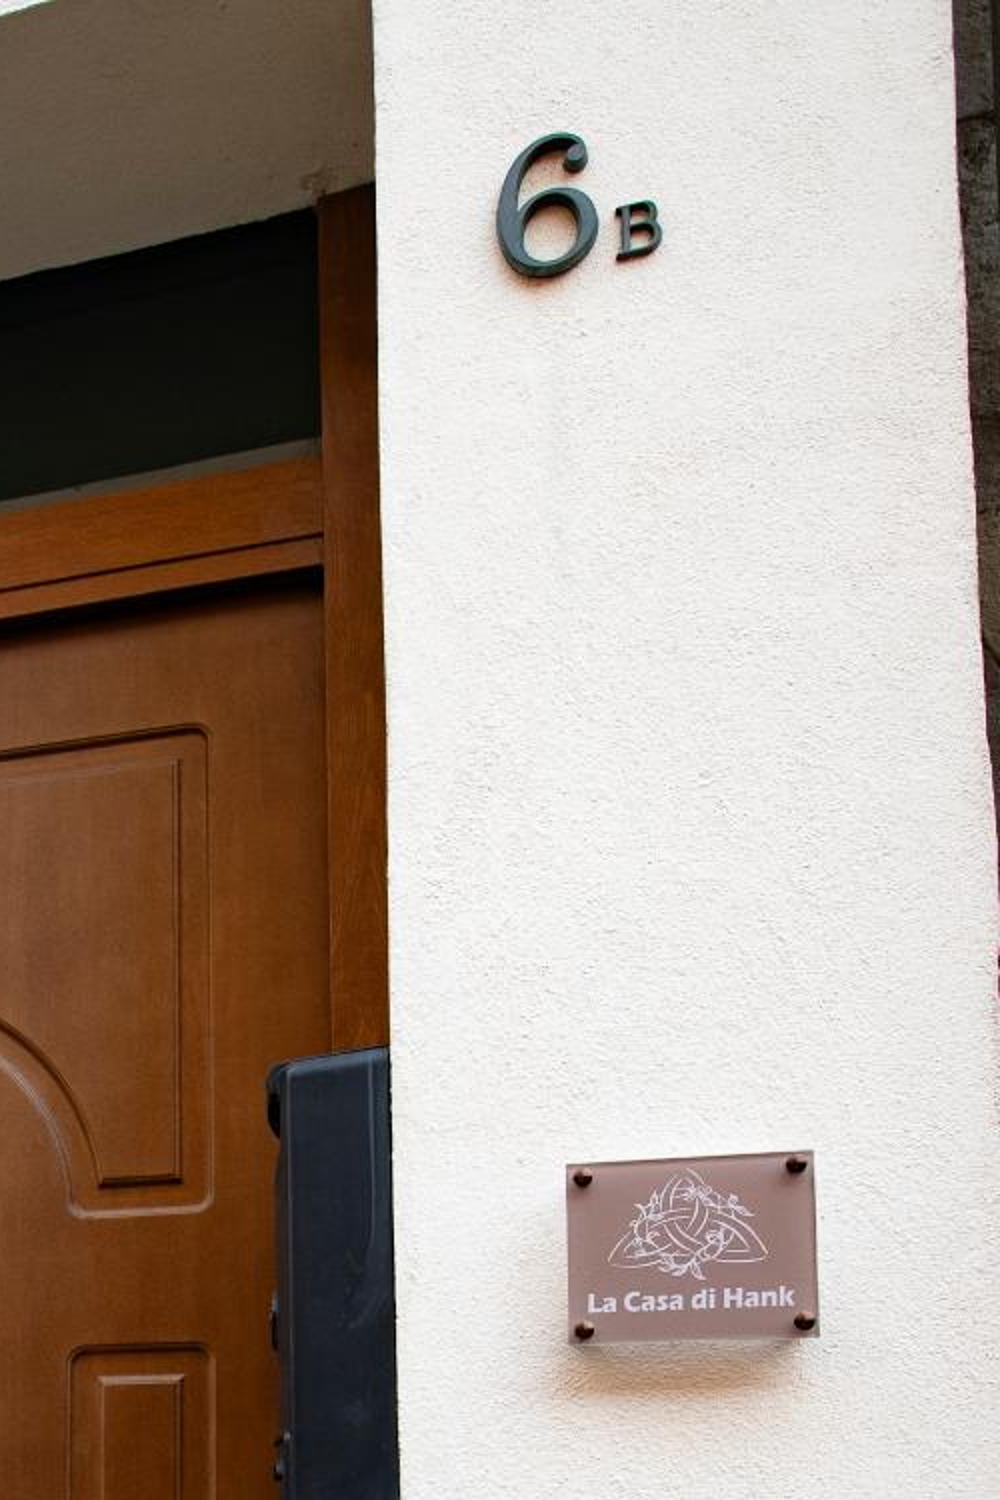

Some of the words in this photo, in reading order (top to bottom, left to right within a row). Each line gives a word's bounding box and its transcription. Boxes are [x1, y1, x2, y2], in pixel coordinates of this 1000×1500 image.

[497, 132, 598, 277] 6
[615, 200, 662, 262] B
[587, 1293, 617, 1313] La
[623, 1291, 684, 1313] Casa
[691, 1288, 716, 1310] di
[723, 1286, 795, 1309] Hank
